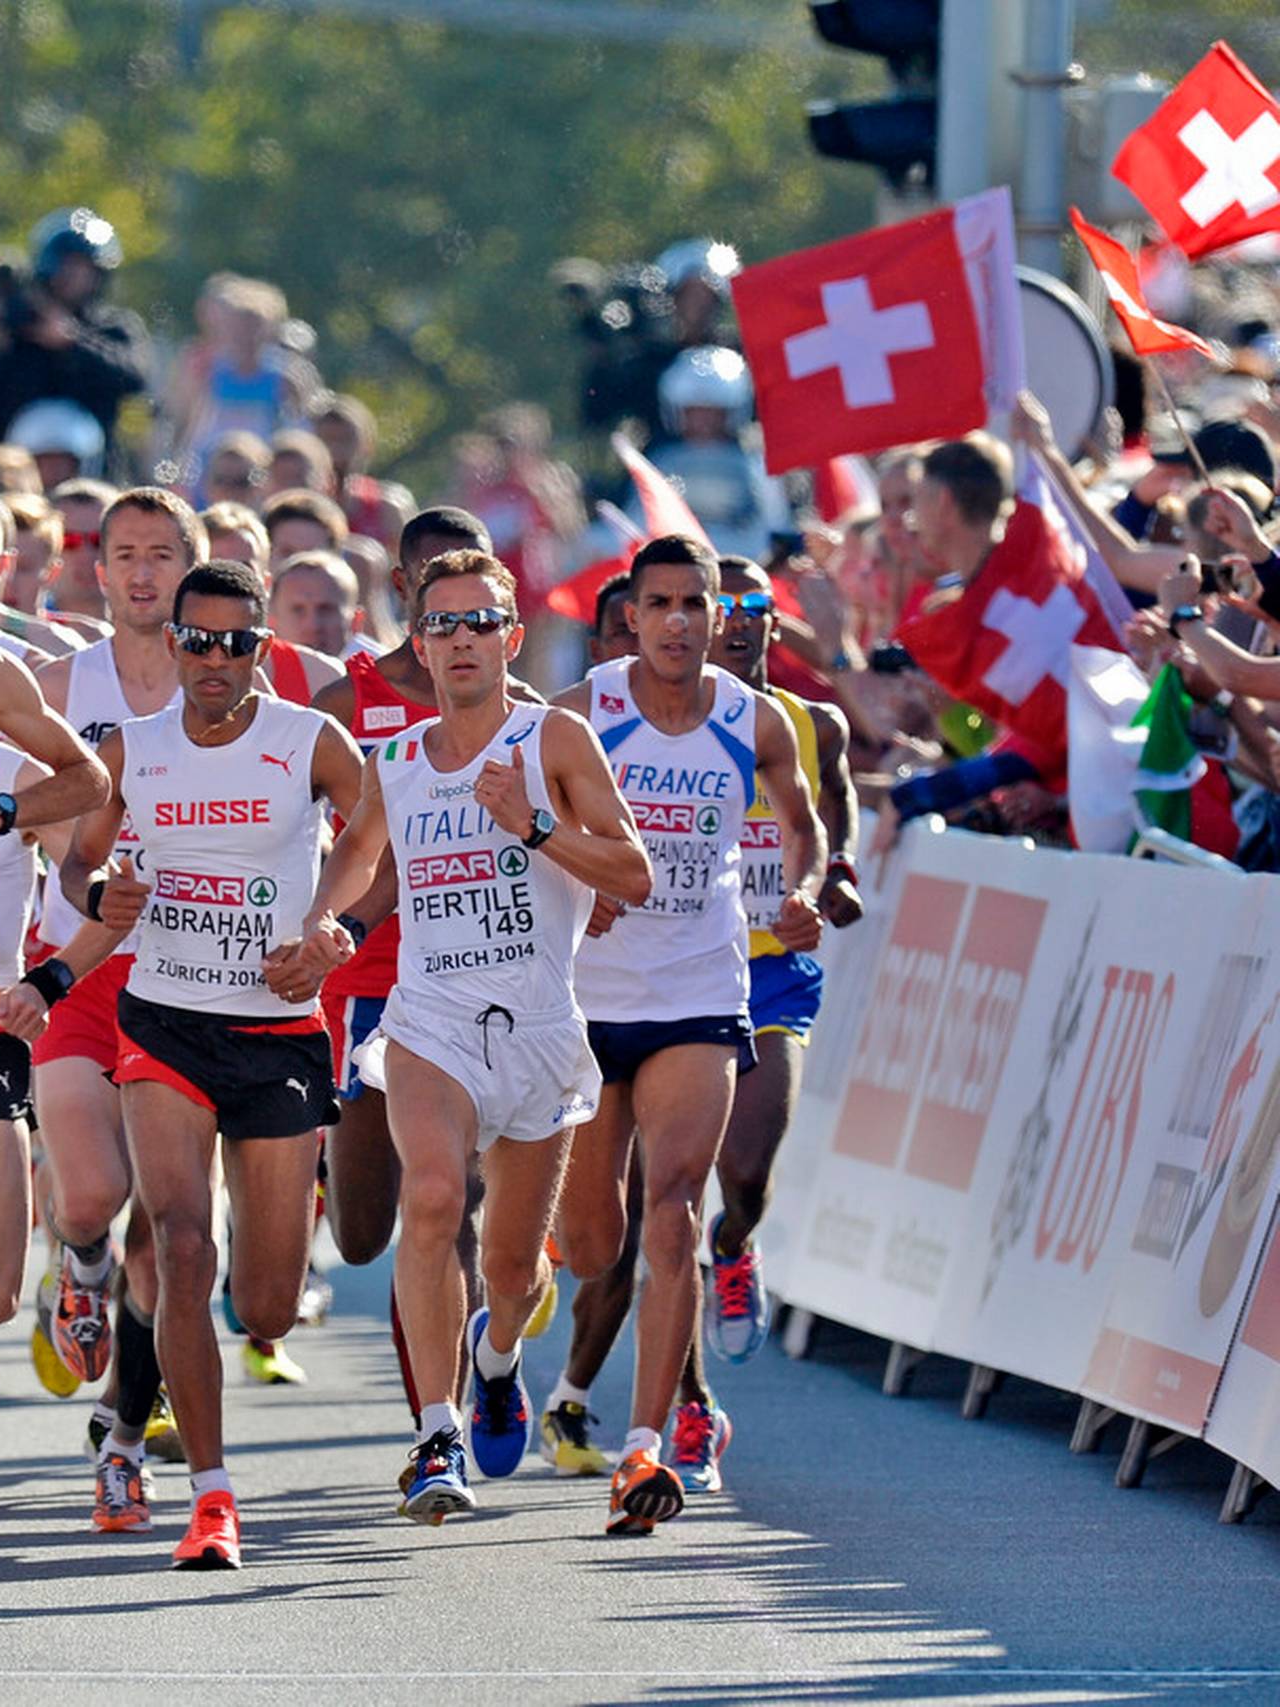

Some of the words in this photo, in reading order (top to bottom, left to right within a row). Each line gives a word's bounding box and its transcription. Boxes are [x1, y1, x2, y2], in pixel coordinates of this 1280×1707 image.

[430, 779, 475, 800] UnipolS
[623, 764, 731, 798] FRANCE
[155, 800, 271, 827] SUISSE
[628, 804, 693, 833] PAR
[741, 823, 781, 846] AR
[408, 851, 495, 889] SPAR
[666, 865, 711, 889] 131
[157, 872, 243, 903] SPAR
[413, 882, 531, 922] PERTILE
[150, 904, 274, 937] ABRAHAM
[479, 909, 534, 939] 149
[218, 937, 268, 961] 171
[425, 950, 489, 974] ZÜRICH
[494, 942, 536, 964] 2014
[228, 970, 267, 987] 2014
[1033, 965, 1175, 1277] UBS
